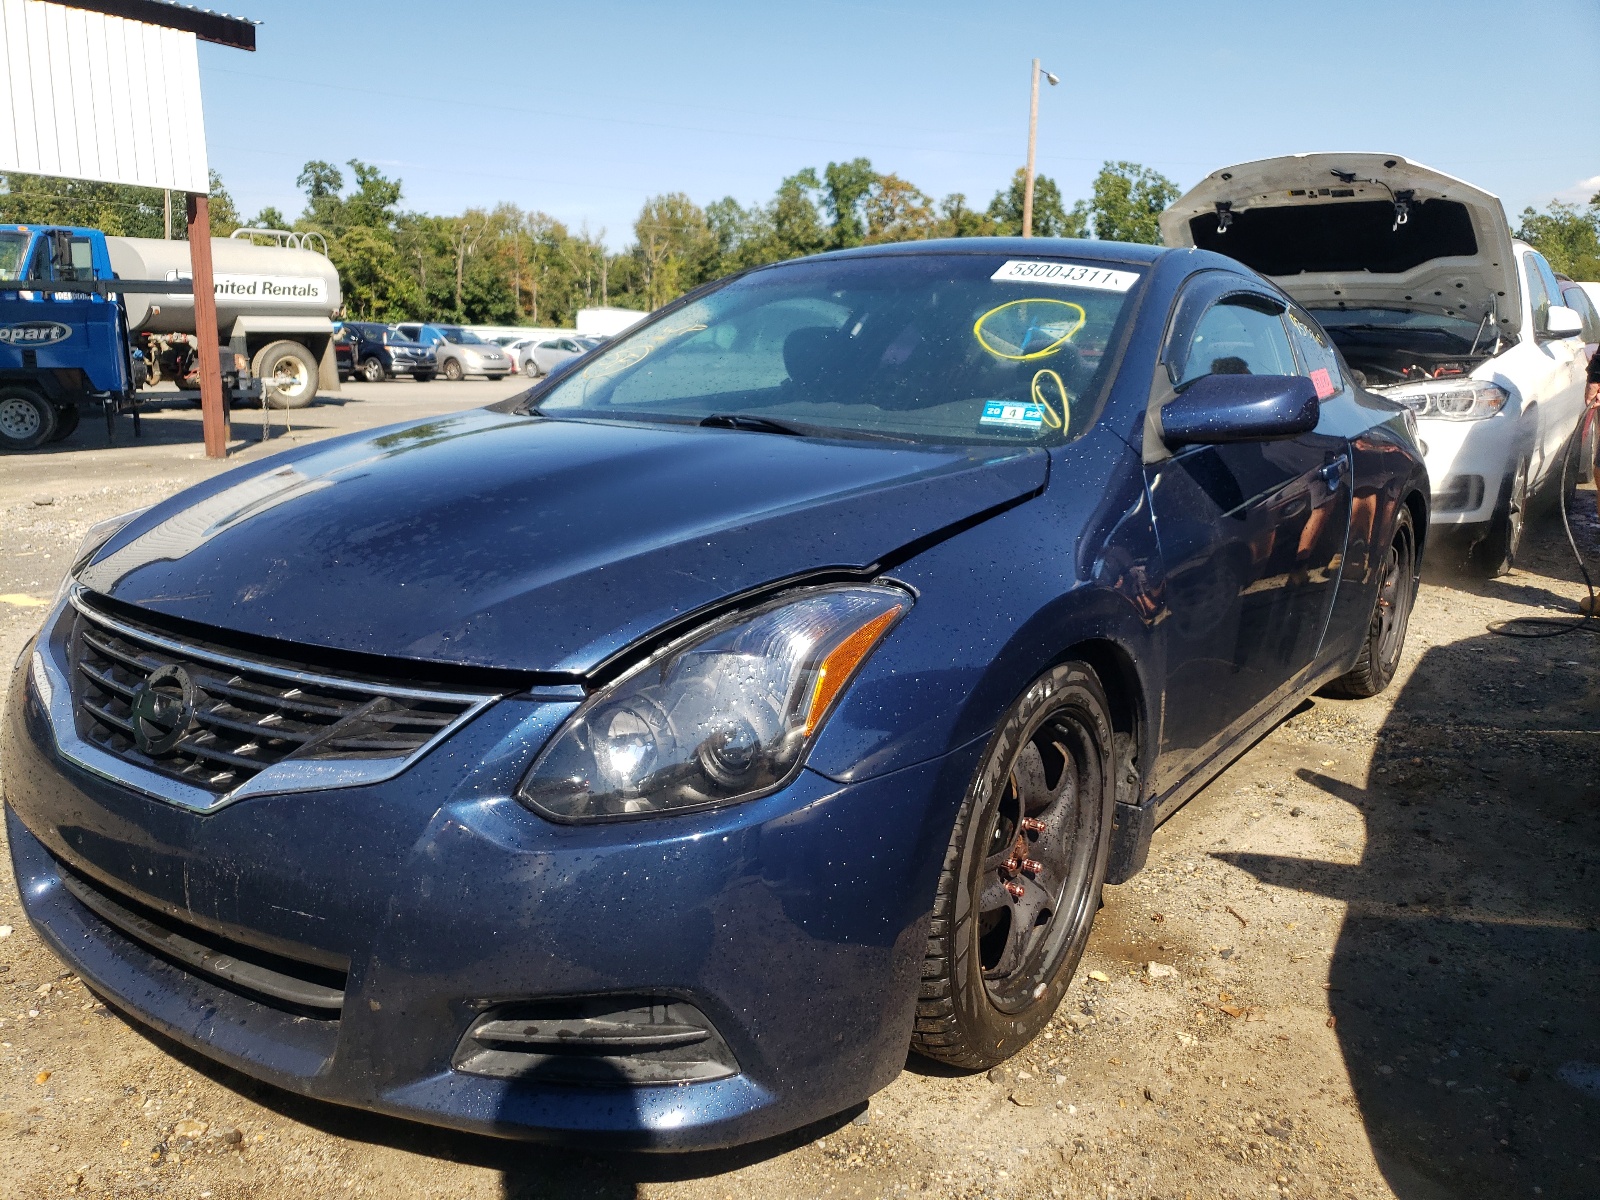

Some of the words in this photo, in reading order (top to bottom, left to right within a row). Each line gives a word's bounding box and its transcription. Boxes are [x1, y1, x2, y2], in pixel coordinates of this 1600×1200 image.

[1009, 262, 1114, 284] 58004311
[214, 279, 258, 296] nited
[262, 281, 320, 298] Rentals
[0, 325, 60, 343] opart
